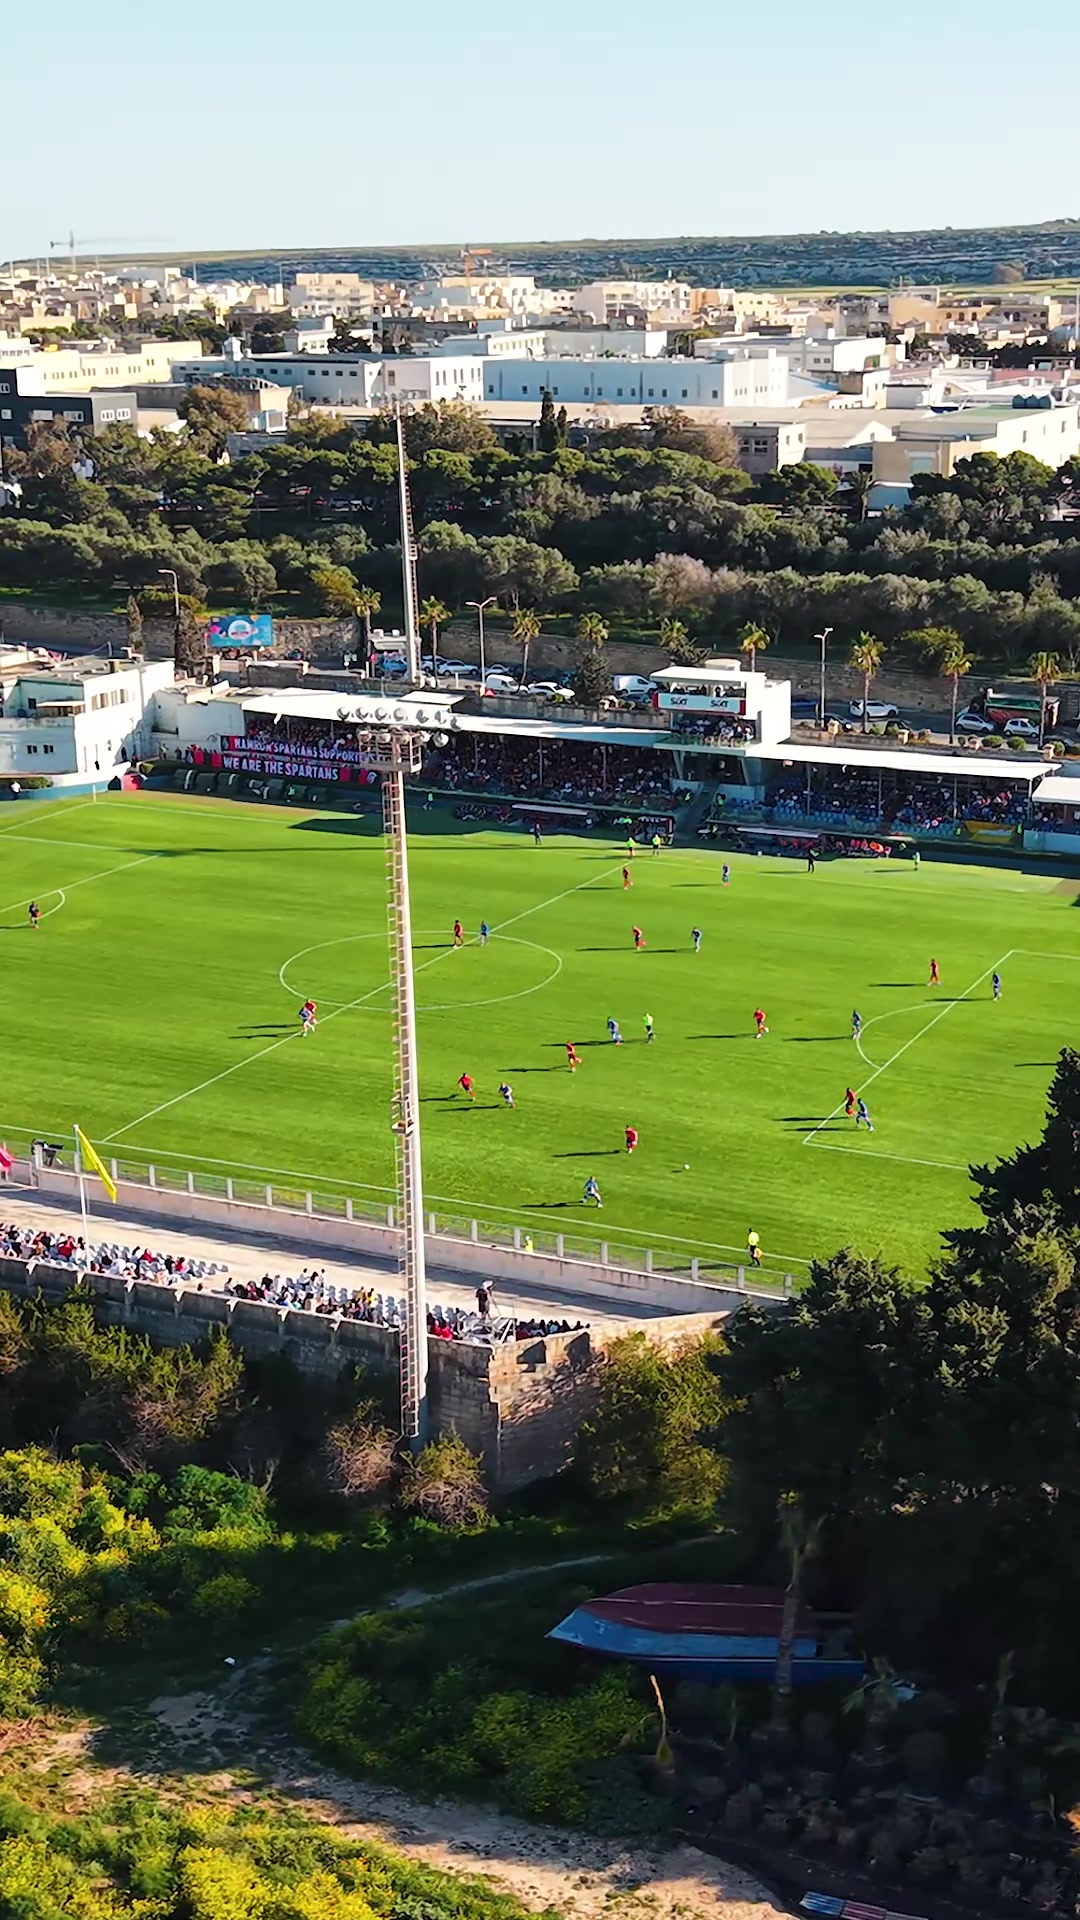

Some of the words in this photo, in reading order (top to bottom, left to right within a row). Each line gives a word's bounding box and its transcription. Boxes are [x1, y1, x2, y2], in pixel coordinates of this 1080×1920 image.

[223, 756, 240, 769] WE
[241, 758, 262, 772] ARE
[264, 760, 284, 775] THE
[285, 762, 339, 781] SPARTANS
